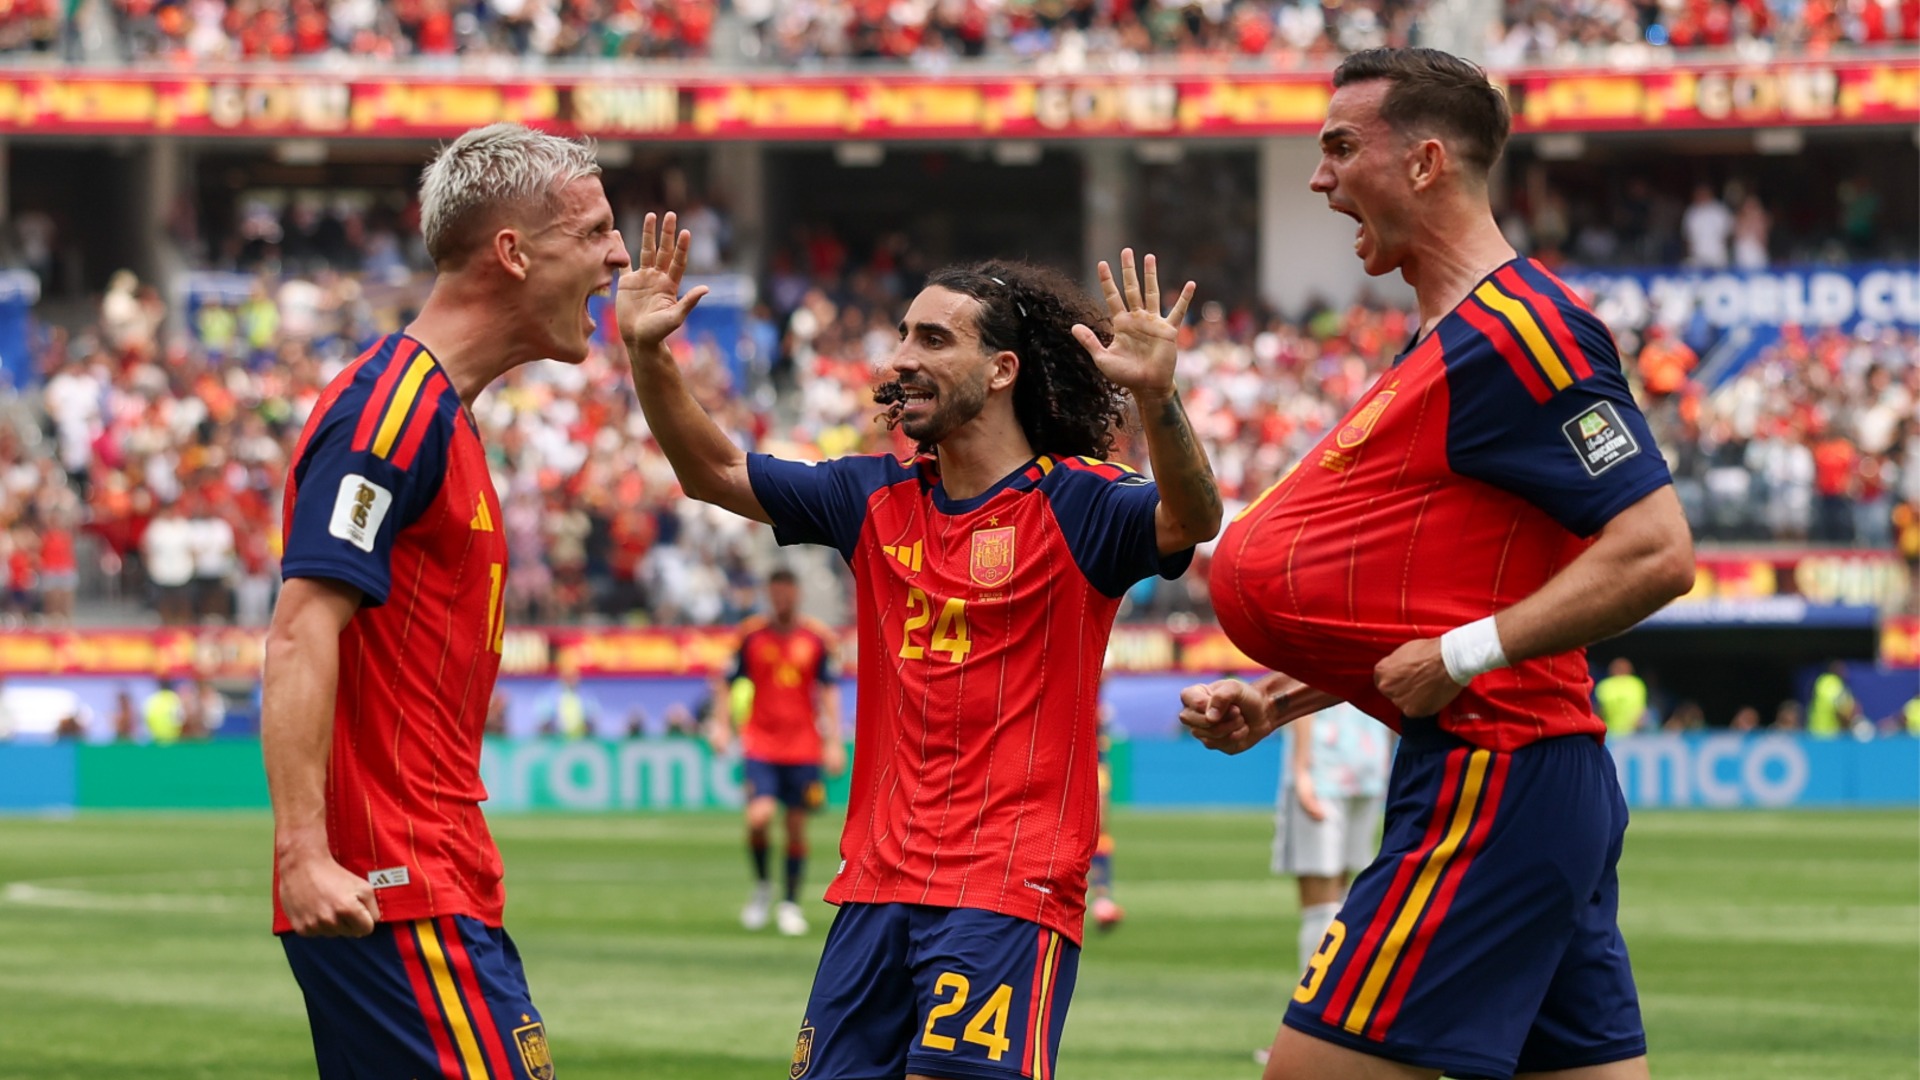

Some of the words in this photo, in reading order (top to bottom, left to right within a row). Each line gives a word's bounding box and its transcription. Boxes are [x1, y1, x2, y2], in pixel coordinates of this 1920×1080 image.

[1652, 271, 1852, 327] WORLD
[486, 562, 505, 654] 1
[899, 587, 971, 663] 24
[483, 738, 752, 807] ramc
[1613, 733, 1807, 807] mco
[921, 971, 1014, 1062] 24
